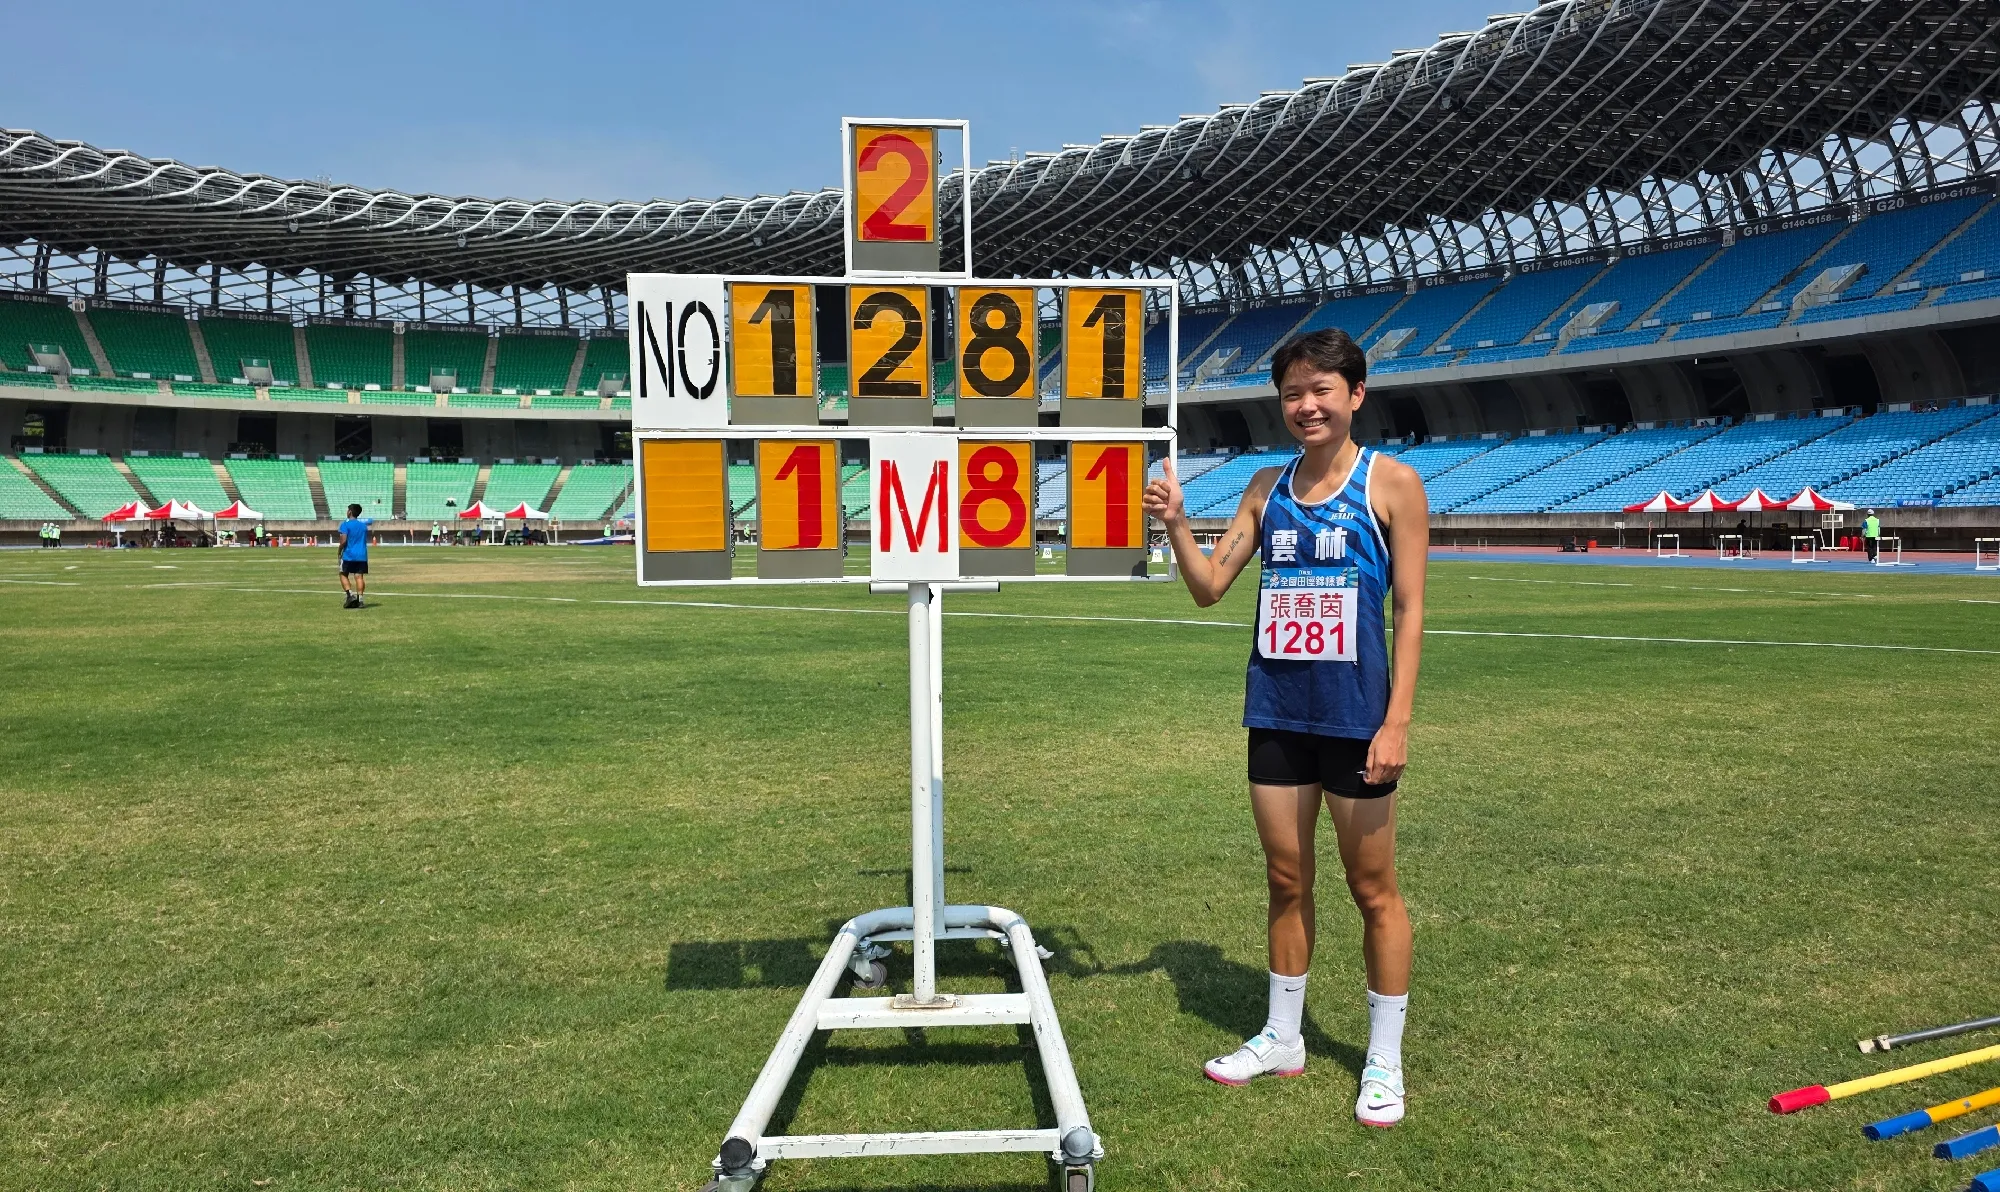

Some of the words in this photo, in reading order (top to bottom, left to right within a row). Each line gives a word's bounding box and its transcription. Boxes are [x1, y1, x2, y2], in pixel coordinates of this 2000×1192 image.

[858, 133, 929, 241] 2
[1877, 197, 1905, 212] G20
[1920, 186, 1977, 204] G160-G178
[1743, 223, 1768, 237] G19
[1782, 213, 1832, 230] G140-G158
[1627, 244, 1651, 256] G18
[1521, 261, 1542, 273] G17
[1552, 255, 1595, 268] G100-G118
[1425, 276, 1445, 287] G16
[1333, 289, 1353, 299] G15
[91, 301, 113, 309] E23
[1250, 300, 1265, 309] F07
[203, 310, 224, 318] E24
[410, 323, 429, 331] E26
[505, 327, 522, 335] E27
[637, 301, 720, 399] NO
[880, 460, 949, 553] M
[1271, 526, 1347, 562] 雲林
[1270, 593, 1344, 619] 張喬茵
[1264, 621, 1345, 655] 1281
